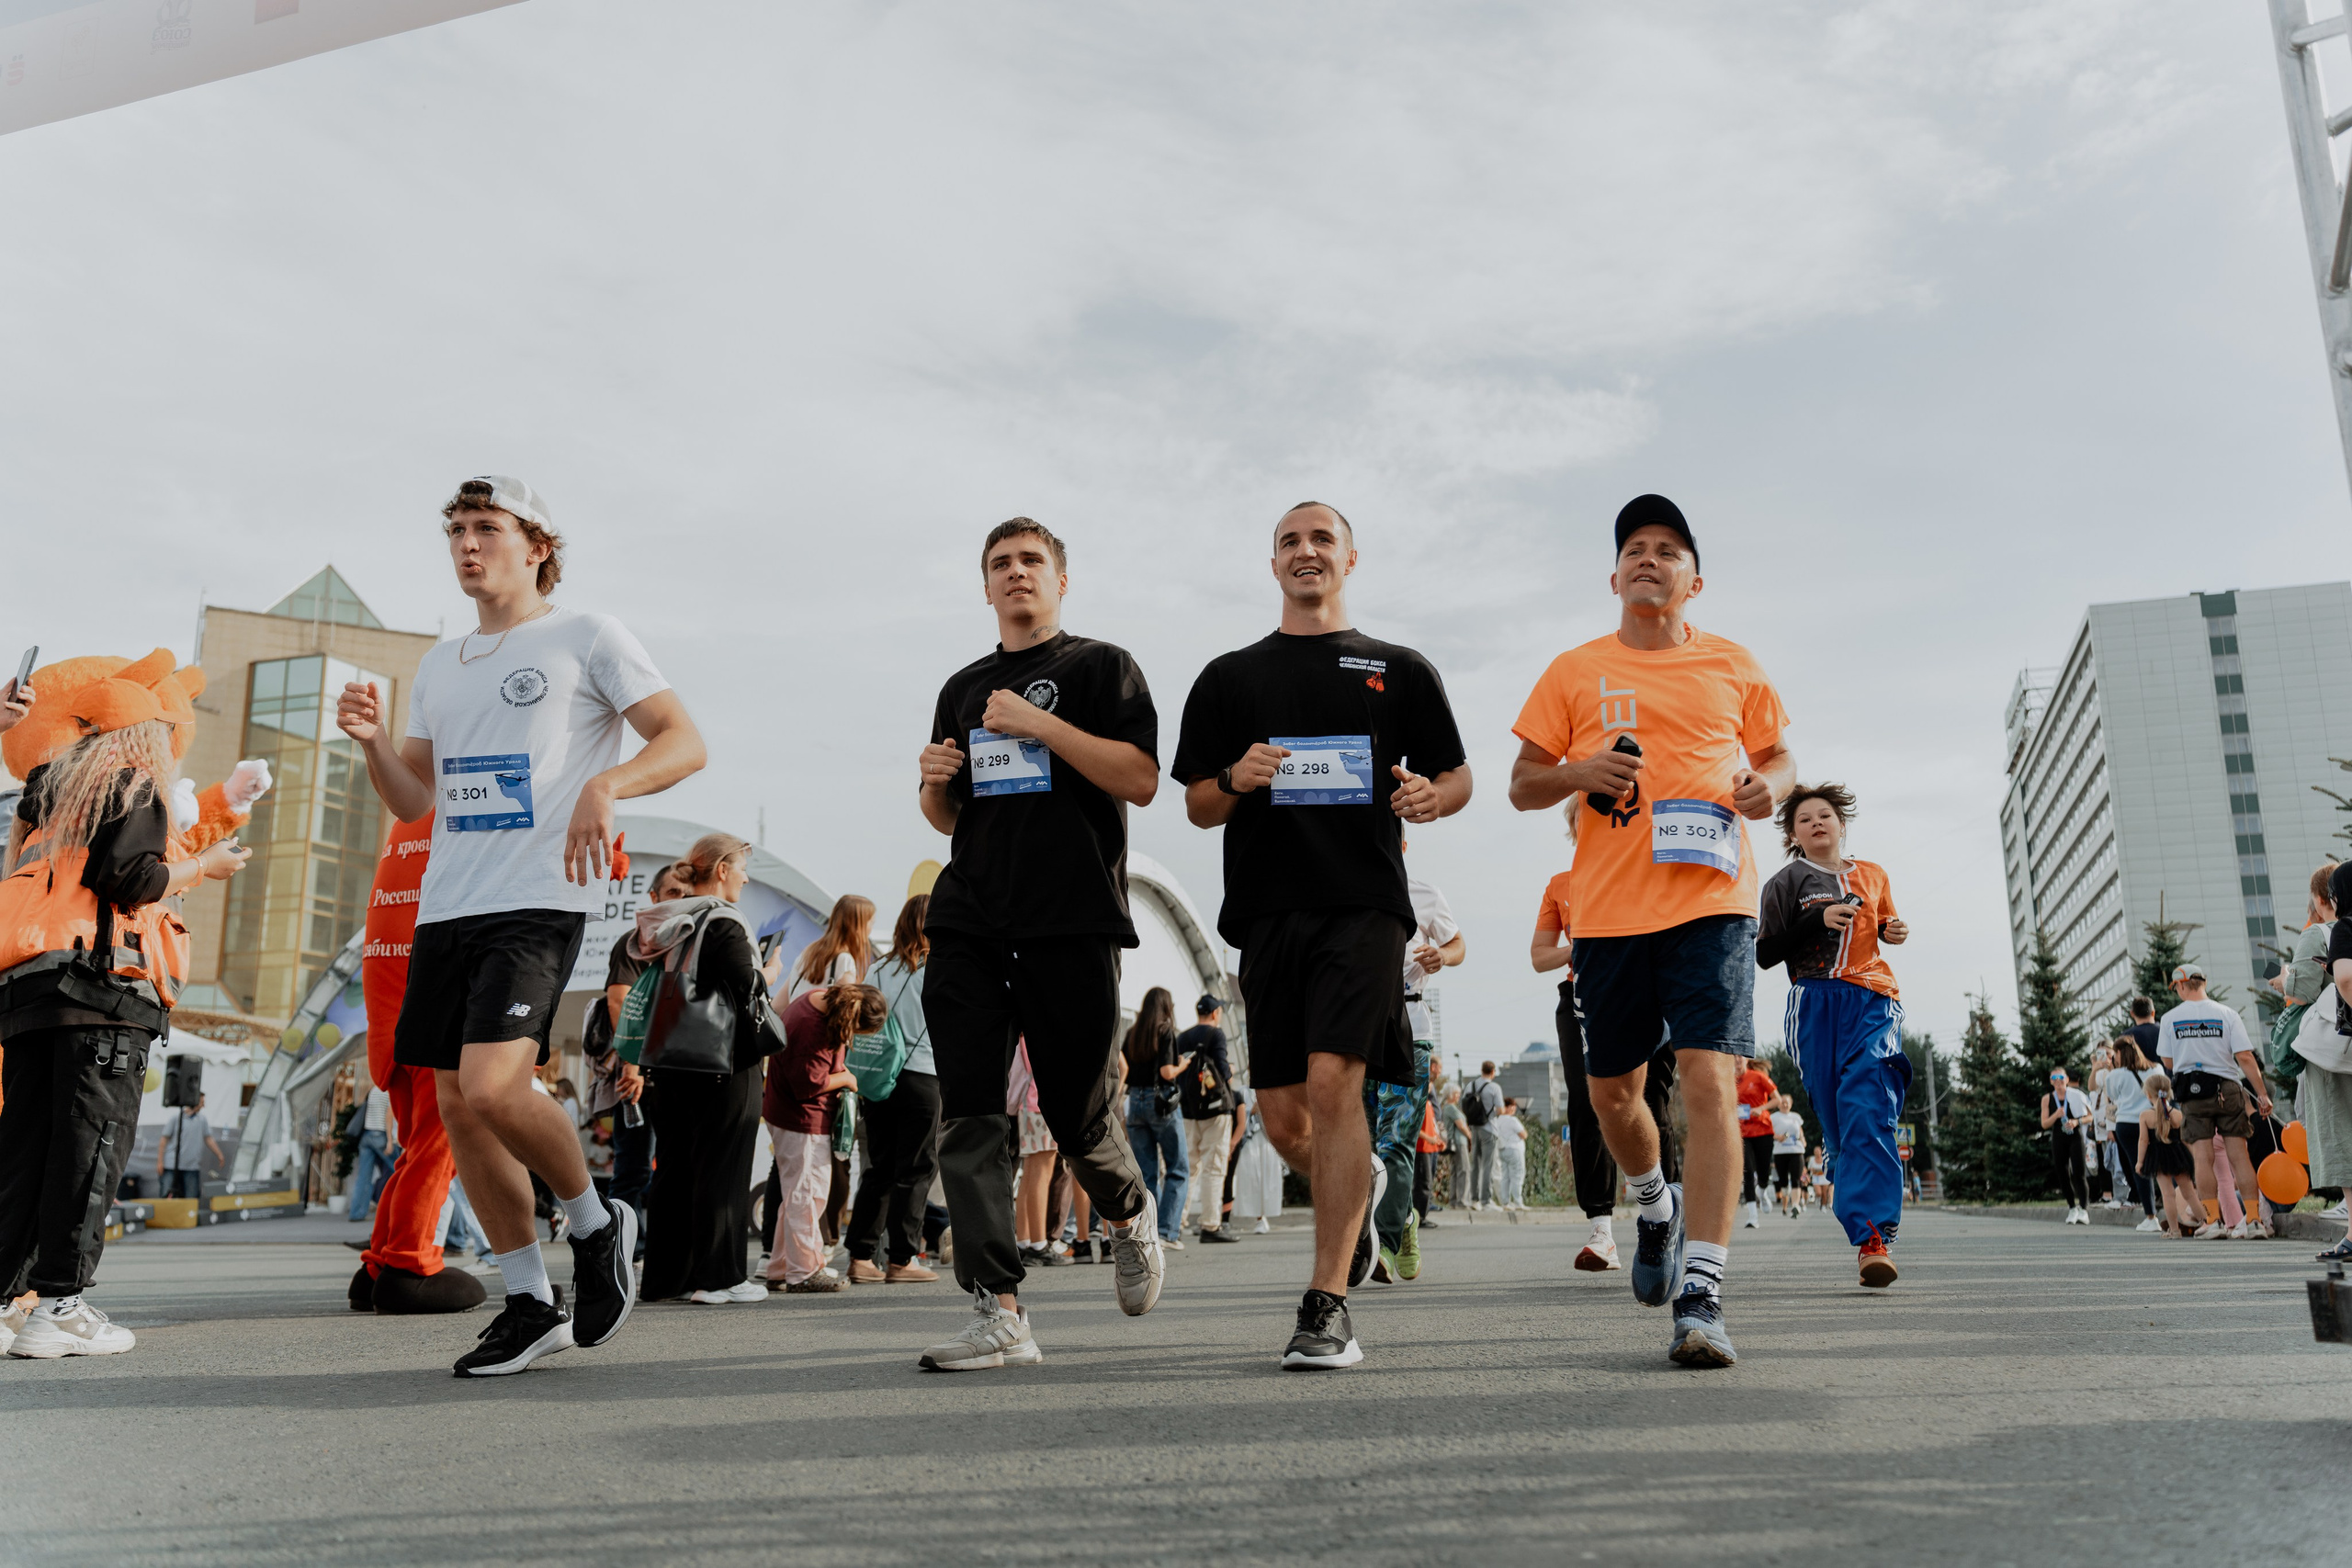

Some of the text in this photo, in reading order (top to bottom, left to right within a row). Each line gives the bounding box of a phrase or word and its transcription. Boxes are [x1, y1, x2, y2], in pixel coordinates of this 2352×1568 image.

[1339, 656, 1369, 664] ФЕДЕРАЦИЯ
[503, 667, 548, 684] ФЕДЕРАЦИЯ БОКСА
[514, 684, 548, 708] ЧЕЛЯБИНСКОЙ
[974, 753, 1011, 770] № 299
[1276, 762, 1329, 775] № 298
[447, 786, 488, 802] № 301
[1659, 825, 1717, 840] № 302
[372, 888, 421, 907] России
[1799, 893, 1833, 904] МАРАФОН
[2177, 1028, 2221, 1039] patagonia
